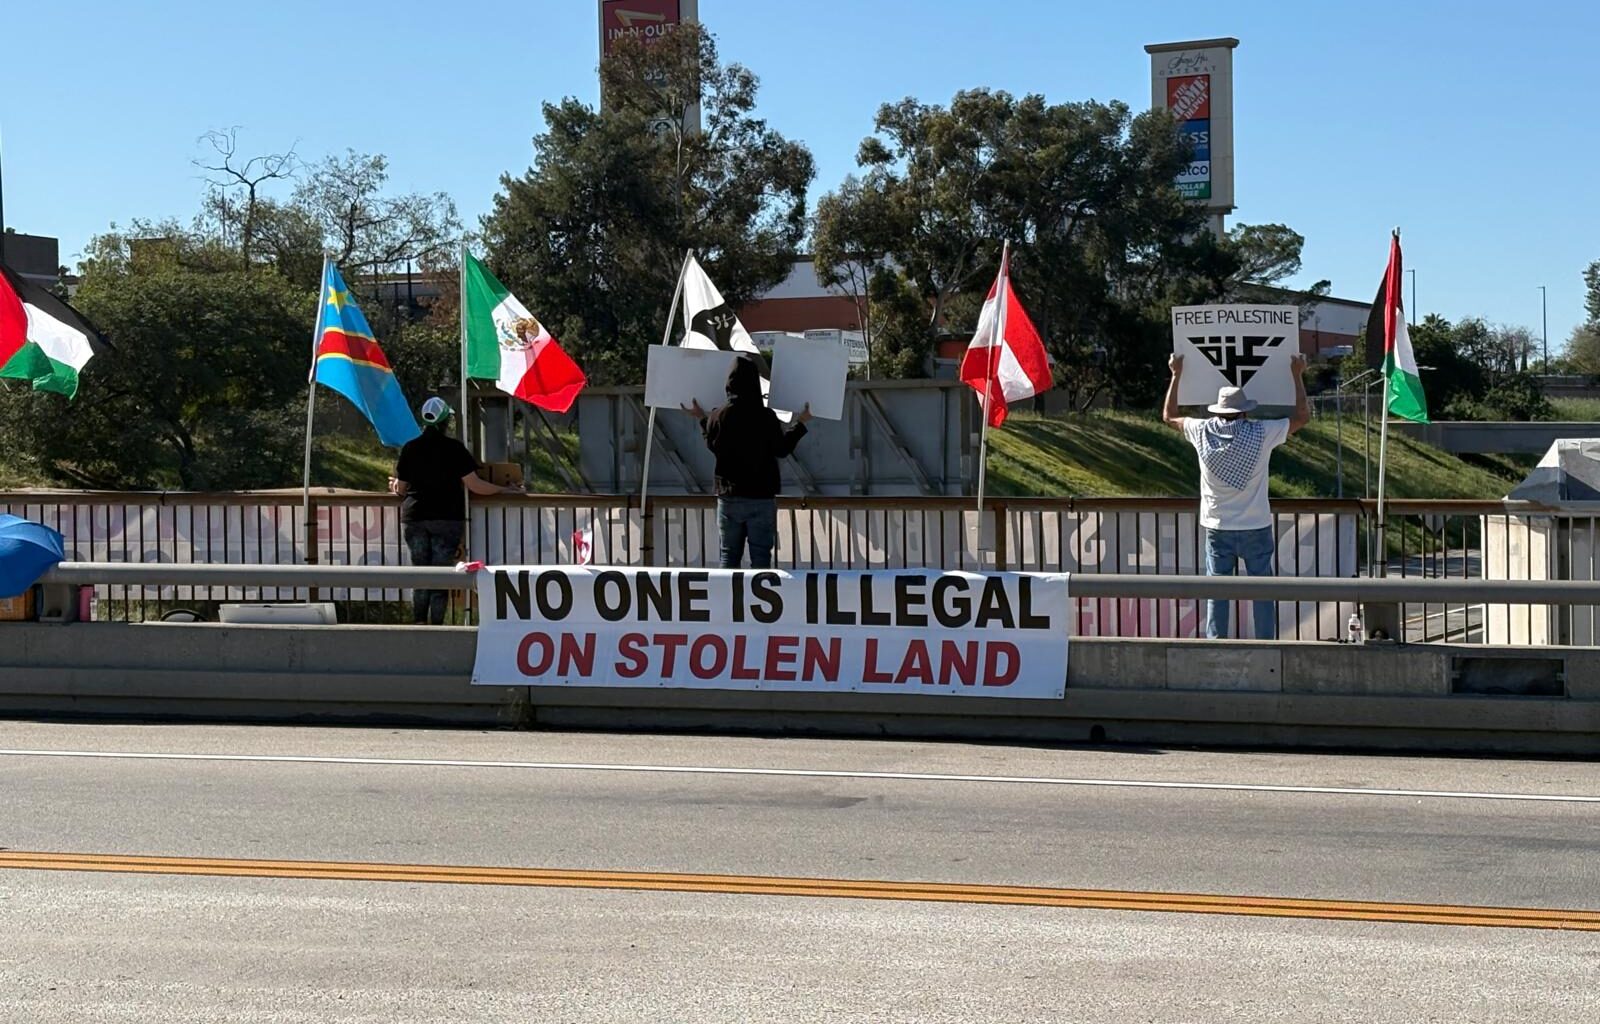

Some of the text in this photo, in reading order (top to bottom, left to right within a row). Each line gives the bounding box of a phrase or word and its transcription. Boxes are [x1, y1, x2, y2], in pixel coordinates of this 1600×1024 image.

[608, 22, 675, 40] IN-N-OUT
[1172, 76, 1208, 119] HOME
[1184, 92, 1208, 120] DEPOT
[1174, 182, 1206, 191] DOLLAR
[1174, 309, 1294, 326] FREE PALESTINE
[494, 570, 1050, 629] NO ONE IS ILLEGAL
[516, 631, 1021, 687] ON STOLEN LAND
